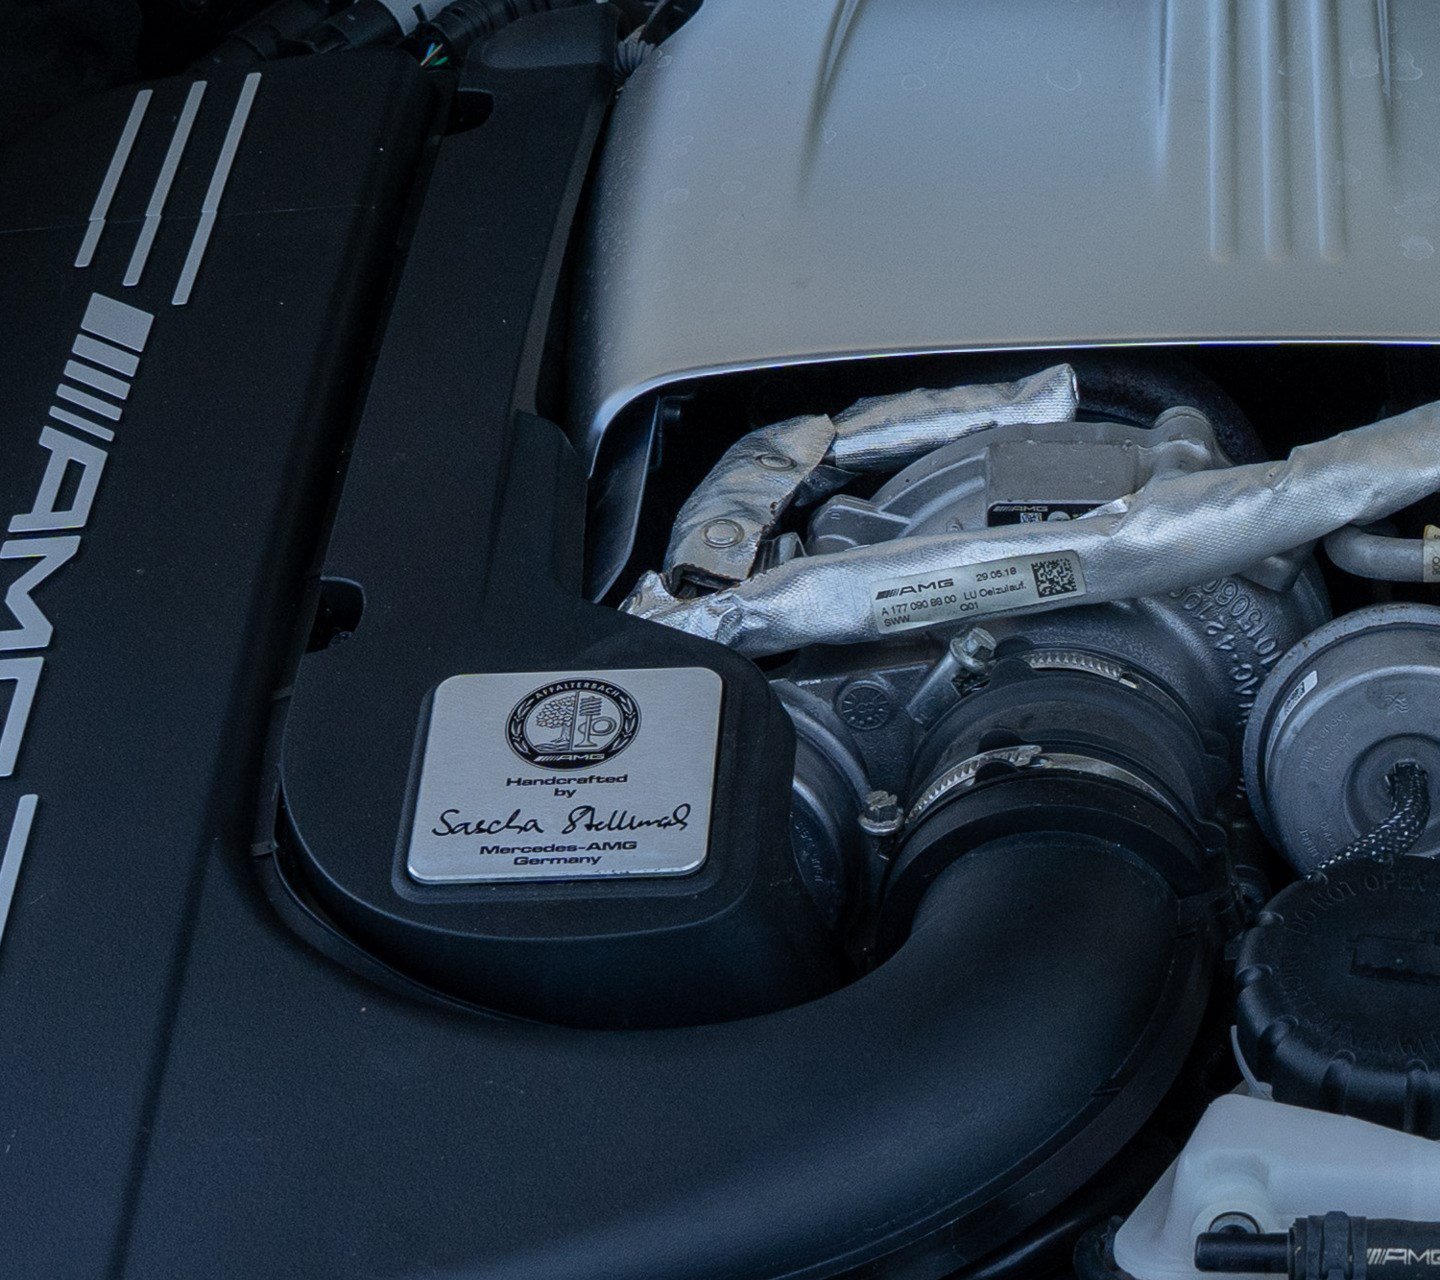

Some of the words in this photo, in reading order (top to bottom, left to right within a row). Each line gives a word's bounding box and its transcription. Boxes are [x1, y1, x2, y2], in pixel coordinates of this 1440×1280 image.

[880, 607, 889, 615] A
[890, 603, 908, 613] 177
[963, 590, 977, 600] LU
[883, 614, 910, 626] SWW
[535, 681, 620, 700] AFFALTERBACH
[507, 774, 627, 786] Handcrafted
[553, 788, 576, 798] by
[480, 841, 637, 855] Mercedes-AMG
[514, 855, 602, 866] Germany
